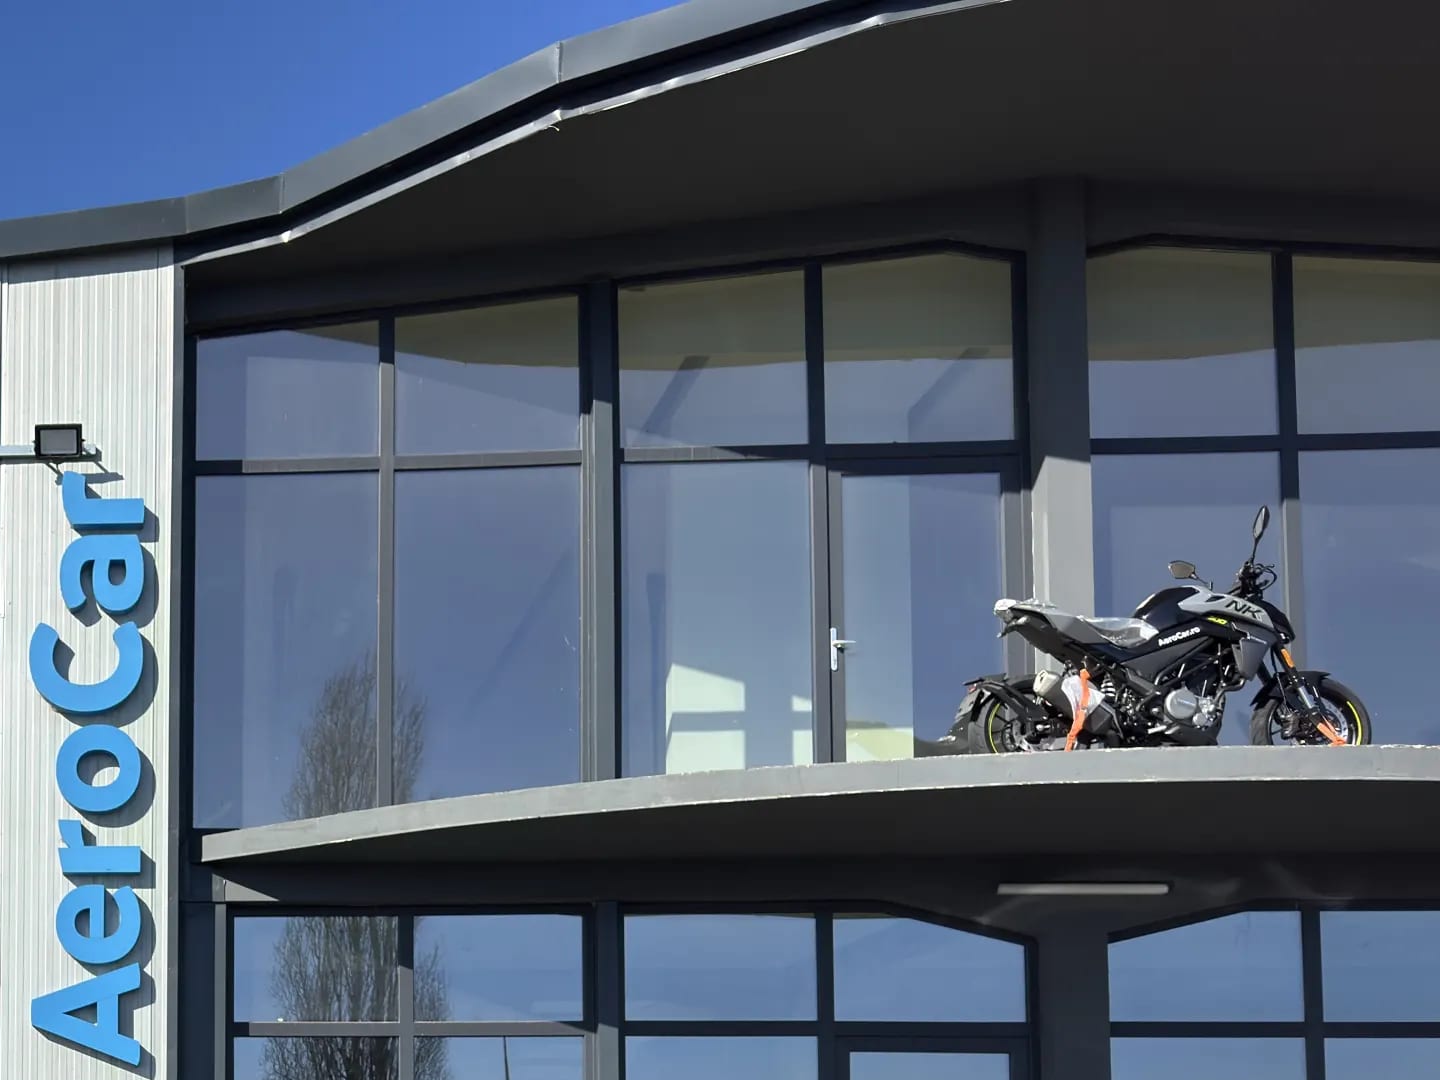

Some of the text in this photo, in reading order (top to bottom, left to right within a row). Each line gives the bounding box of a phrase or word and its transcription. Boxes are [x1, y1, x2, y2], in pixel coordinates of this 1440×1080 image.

[1225, 600, 1262, 619] NK
[1158, 626, 1201, 647] AeroCar.ro
[29, 470, 145, 1067] AeroCar
